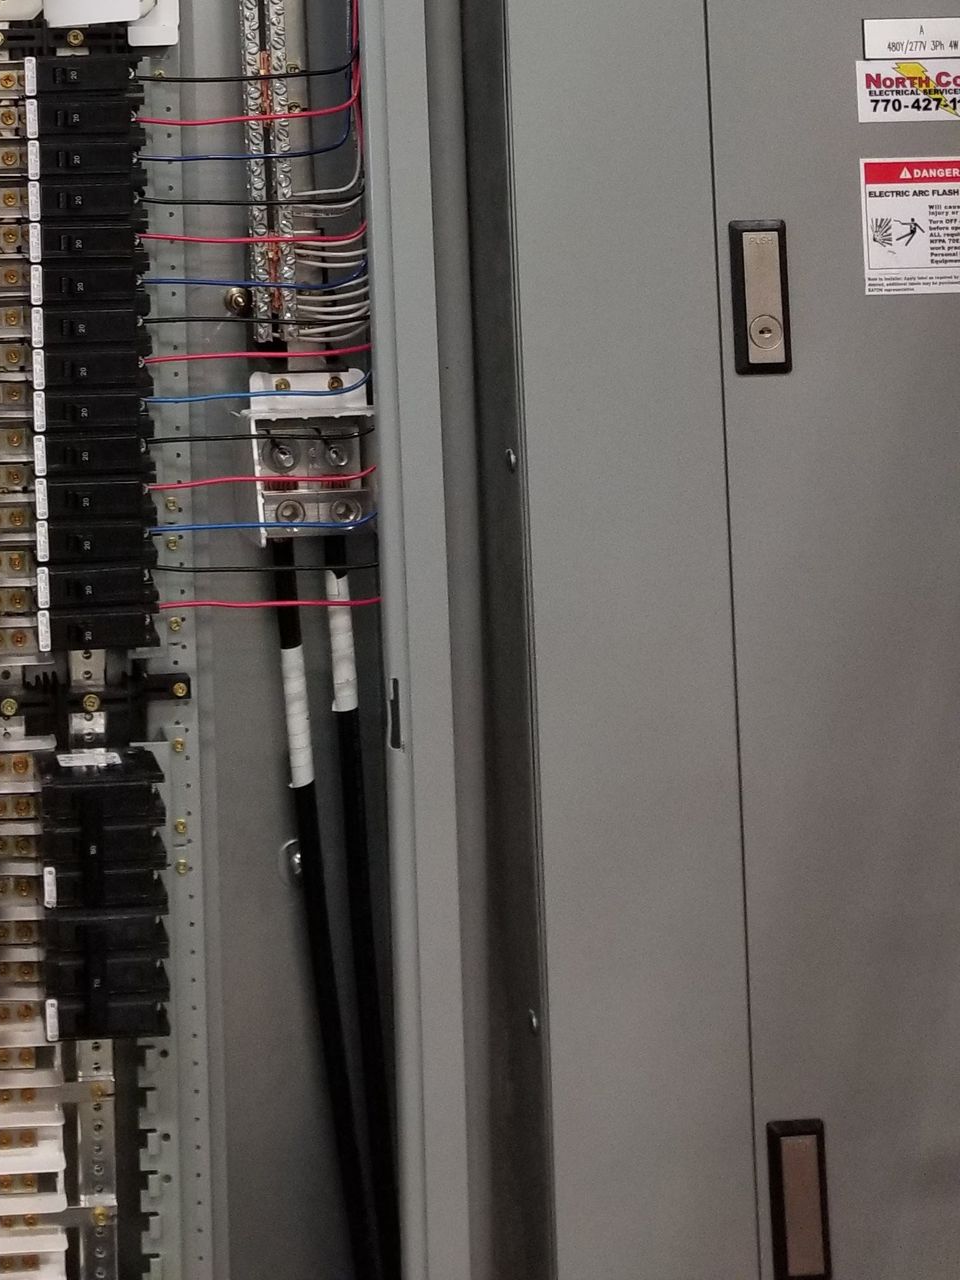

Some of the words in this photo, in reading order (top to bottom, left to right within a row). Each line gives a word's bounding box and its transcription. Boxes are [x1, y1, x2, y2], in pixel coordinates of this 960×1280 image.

[919, 24, 925, 35] A
[887, 40, 927, 54] 480Y/277V
[931, 40, 945, 51] 3Ph
[949, 40, 959, 50] 4W
[869, 89, 920, 97] ELECTRICAL
[913, 168, 960, 178] DANGER
[868, 190, 910, 198] ELECTRIC
[912, 189, 929, 197] ARC
[932, 188, 959, 196] FLASH
